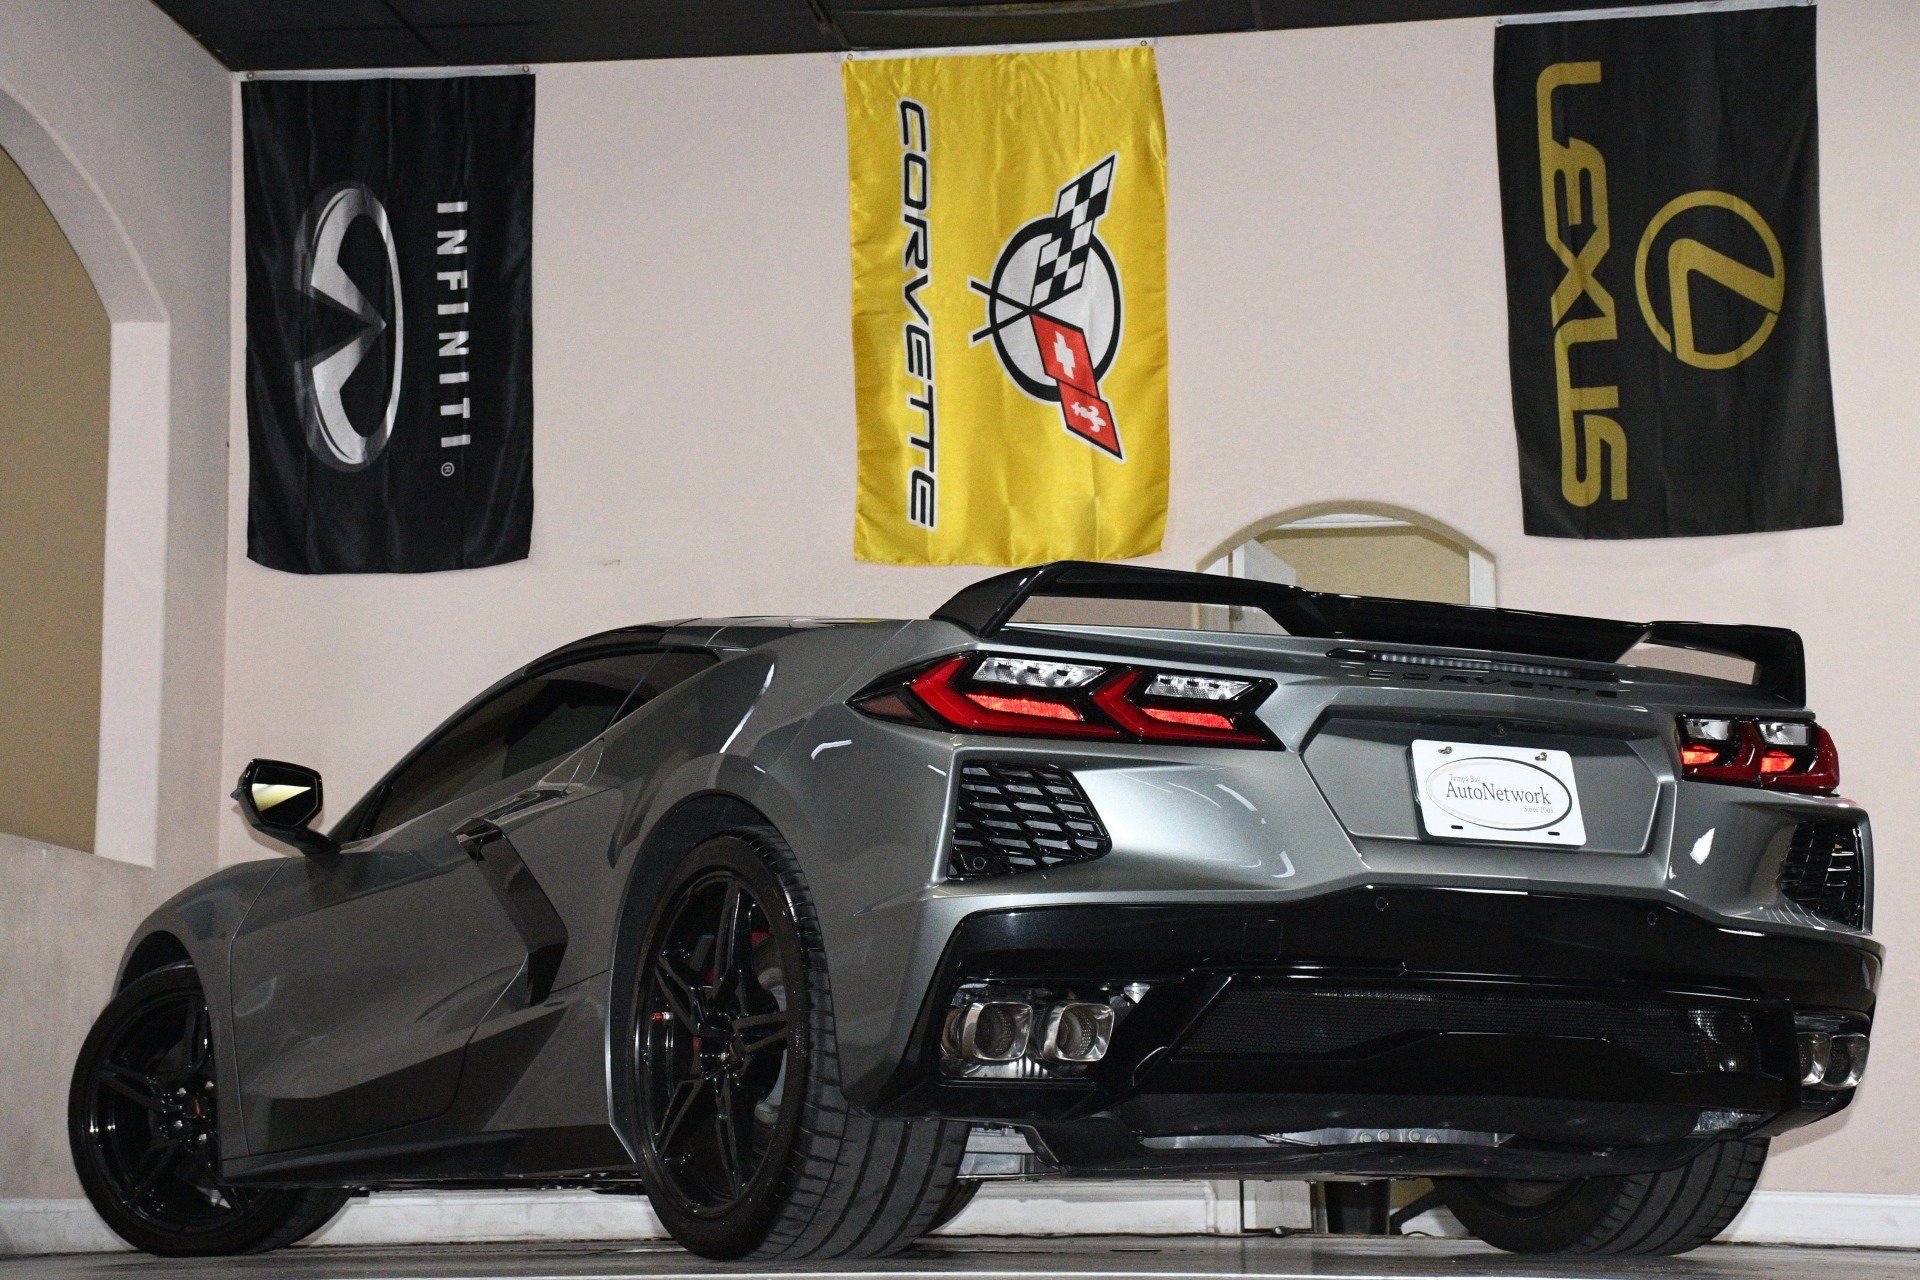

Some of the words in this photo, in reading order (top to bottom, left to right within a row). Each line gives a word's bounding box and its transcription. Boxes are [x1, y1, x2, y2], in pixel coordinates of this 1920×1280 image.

[436, 201, 471, 448] INFINITI
[898, 98, 939, 531] CORVETTE
[1536, 60, 1629, 508] LEXUS
[1445, 780, 1552, 805] AutoNetwork
